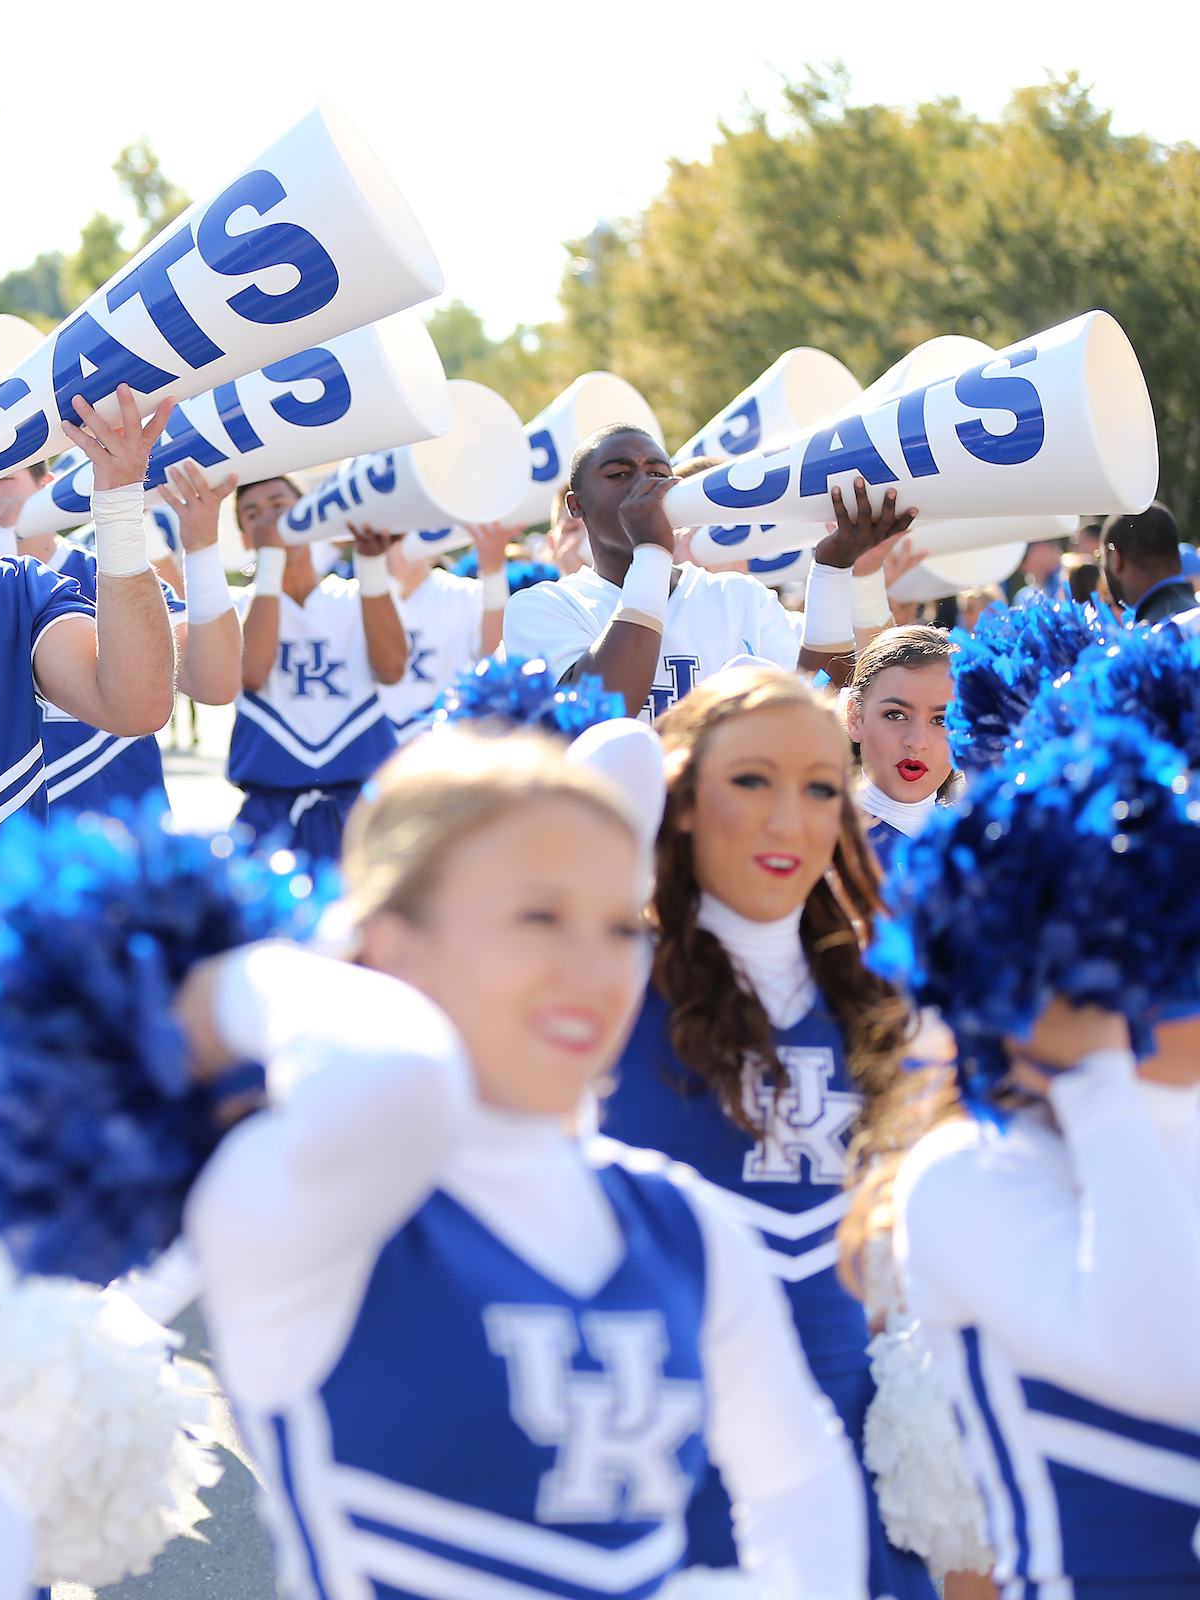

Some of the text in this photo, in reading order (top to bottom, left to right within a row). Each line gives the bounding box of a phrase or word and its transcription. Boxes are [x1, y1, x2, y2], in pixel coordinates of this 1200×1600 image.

[702, 346, 1045, 509] CATS
[278, 640, 348, 699] UK
[482, 1301, 705, 1525] UK
